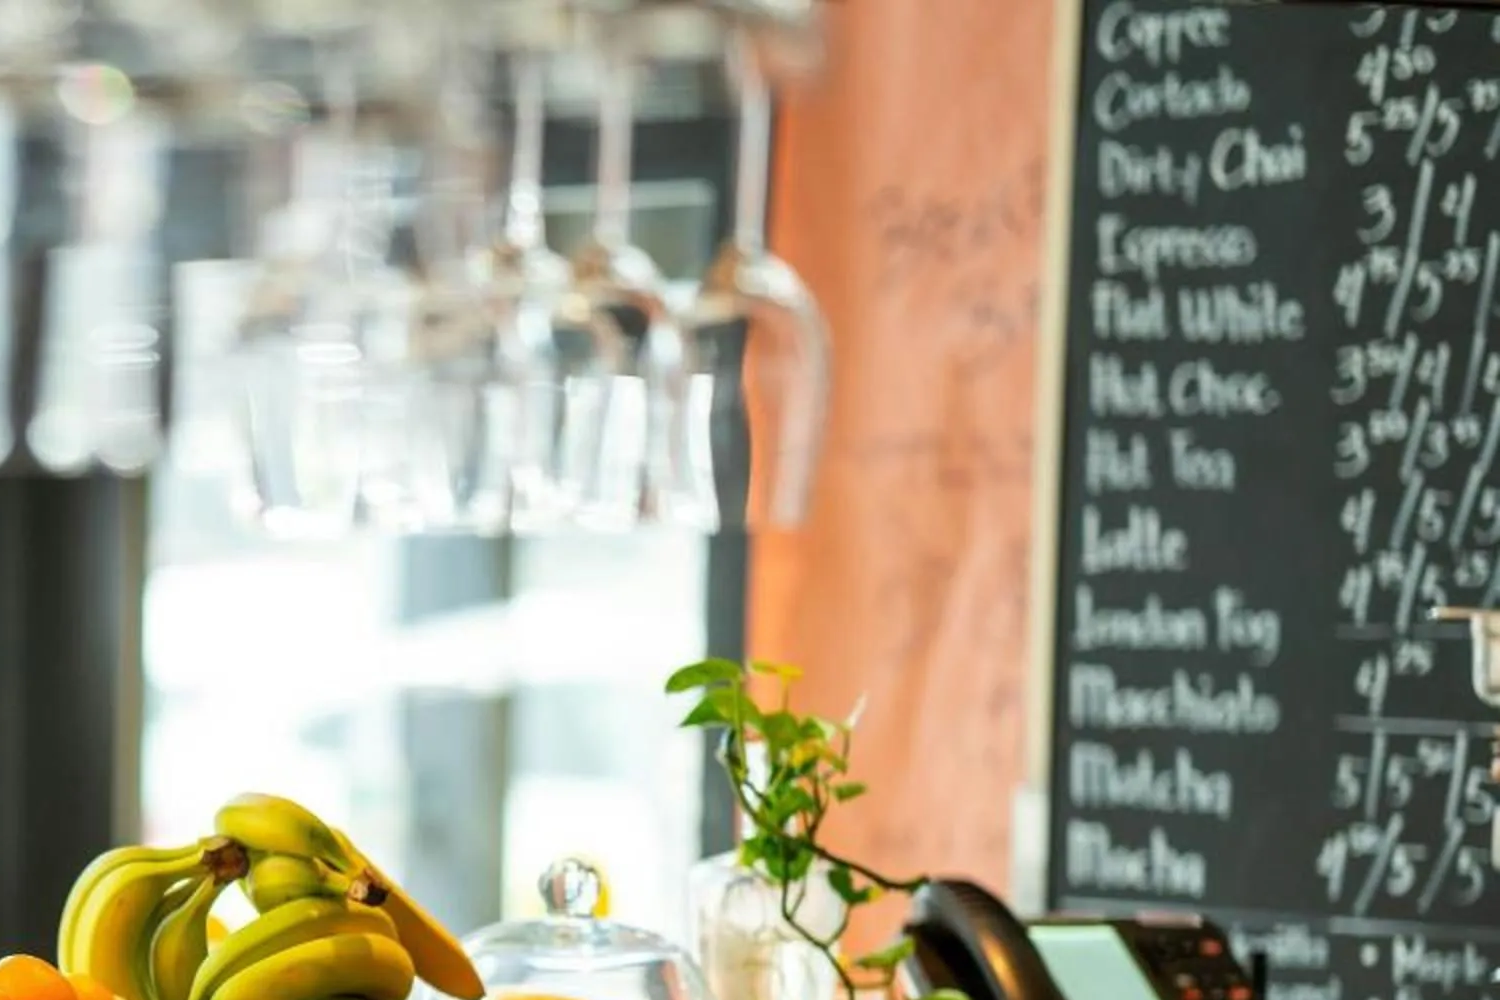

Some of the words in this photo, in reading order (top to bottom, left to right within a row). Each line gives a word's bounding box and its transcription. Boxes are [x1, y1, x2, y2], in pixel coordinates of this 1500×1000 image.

[1094, 67, 1251, 132] Cortado
[1098, 137, 1200, 203] Dirty
[1209, 122, 1306, 191] Chai
[1093, 279, 1168, 340] Flat
[1179, 279, 1306, 344] White
[1089, 351, 1164, 418] Hot
[1085, 427, 1152, 495] Hot
[1168, 427, 1235, 492] Tea
[1082, 503, 1189, 576] Latte
[1073, 581, 1207, 652] London
[1212, 584, 1281, 667] Fog
[1069, 740, 1233, 821] Matcha
[1065, 816, 1207, 899] Mocha
